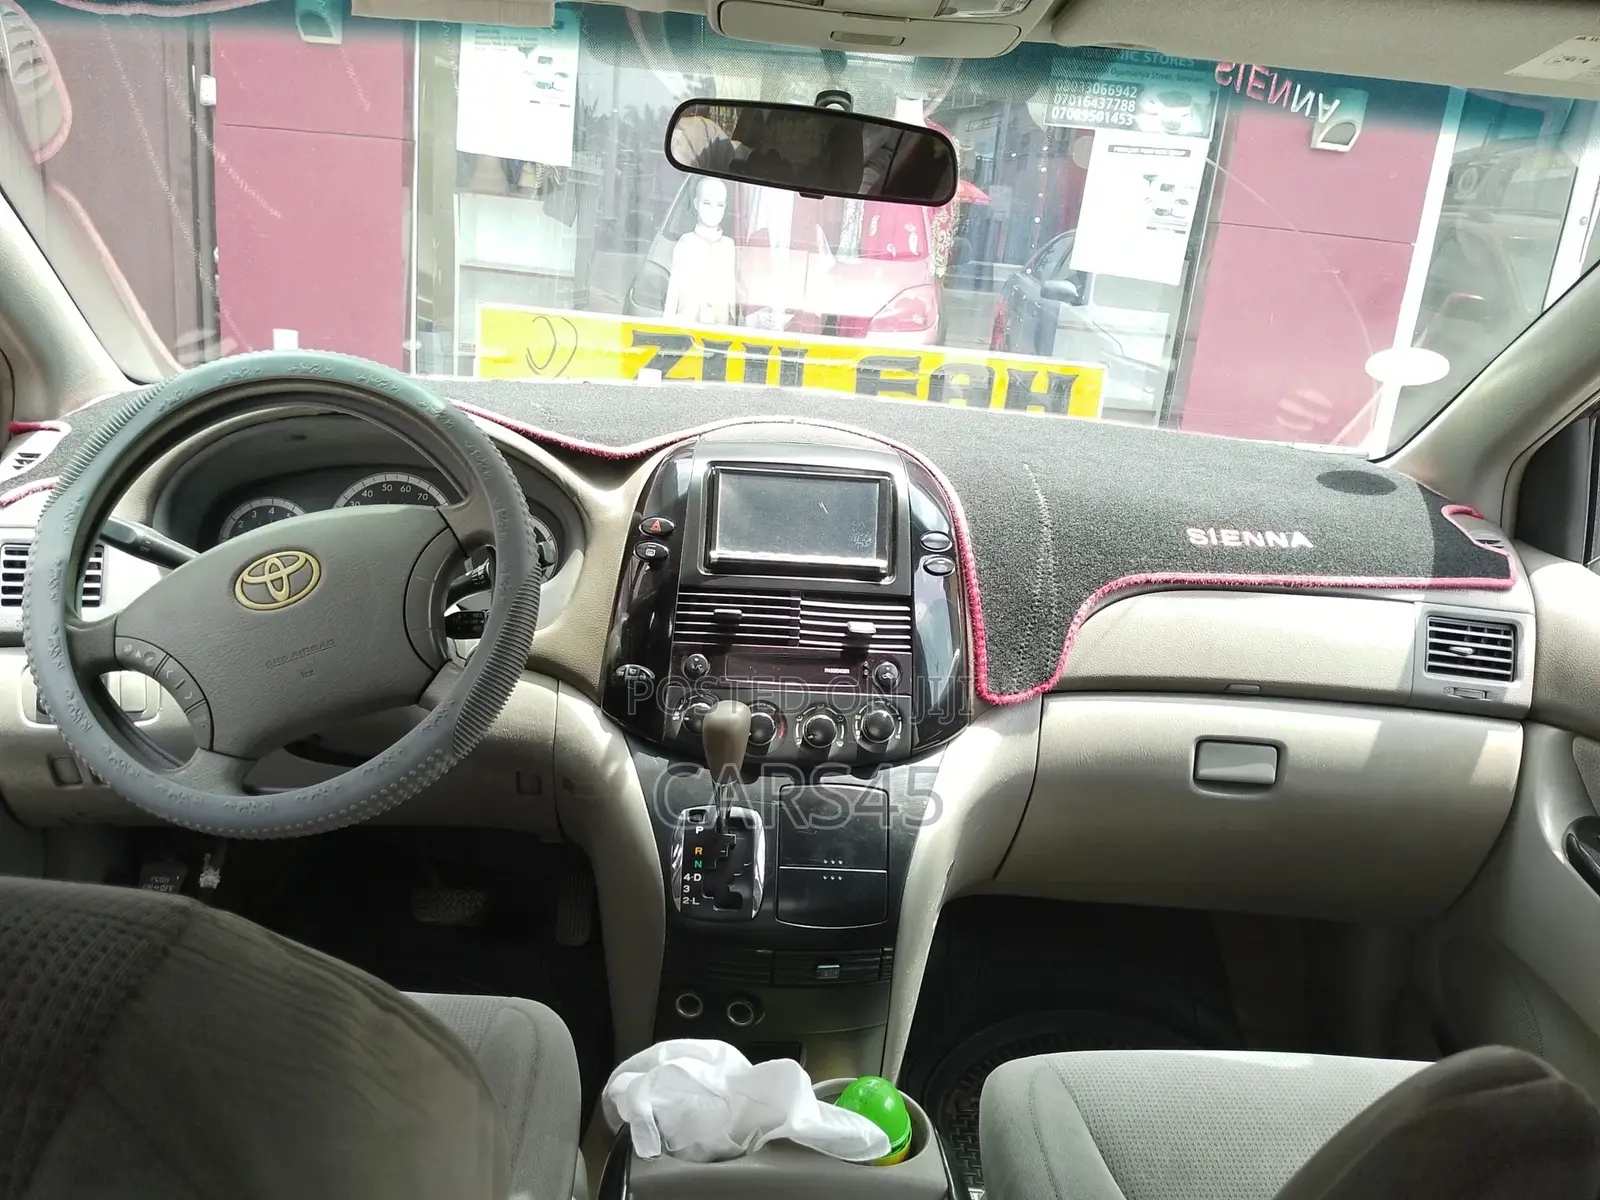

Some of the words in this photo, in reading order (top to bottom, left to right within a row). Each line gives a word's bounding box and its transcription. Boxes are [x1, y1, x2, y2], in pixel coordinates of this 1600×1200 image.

[1144, 51, 1196, 67] STORES
[381, 484, 393, 492] 50
[400, 485, 412, 493] 60
[362, 490, 373, 498] 40
[417, 493, 429, 501] 70
[1186, 527, 1314, 549] SIENNA
[695, 826, 704, 834] P
[694, 846, 703, 855] R
[694, 860, 702, 868] N
[683, 885, 690, 893] 3
